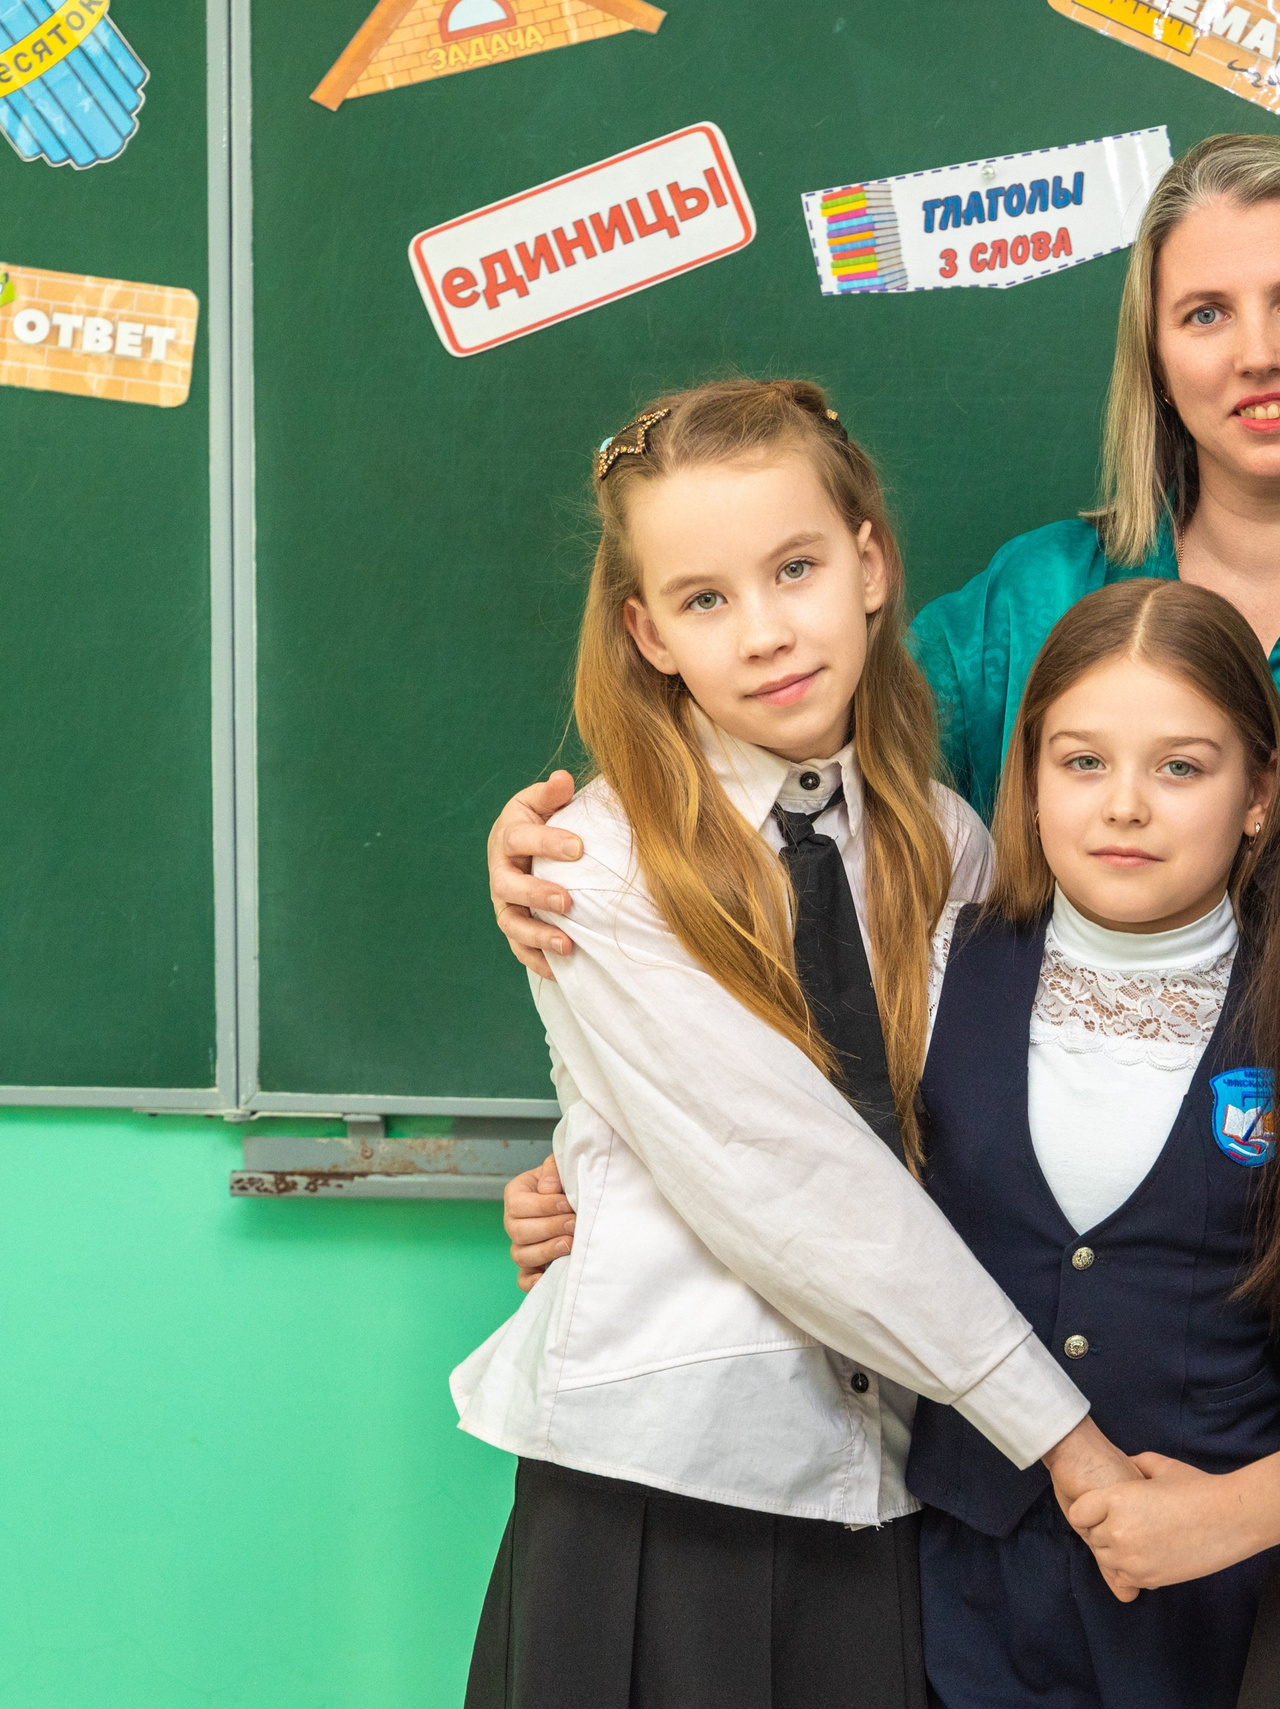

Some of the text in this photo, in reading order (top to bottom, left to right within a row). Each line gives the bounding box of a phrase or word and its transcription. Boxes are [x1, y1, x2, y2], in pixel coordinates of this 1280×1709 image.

[427, 25, 545, 71] ЗАДАЧА
[922, 171, 1084, 233] ГЛАГОЛЫ
[440, 167, 730, 311] единицы
[939, 227, 1072, 279] 3 СЛОВА
[13, 308, 176, 362] ОТВЕТ
